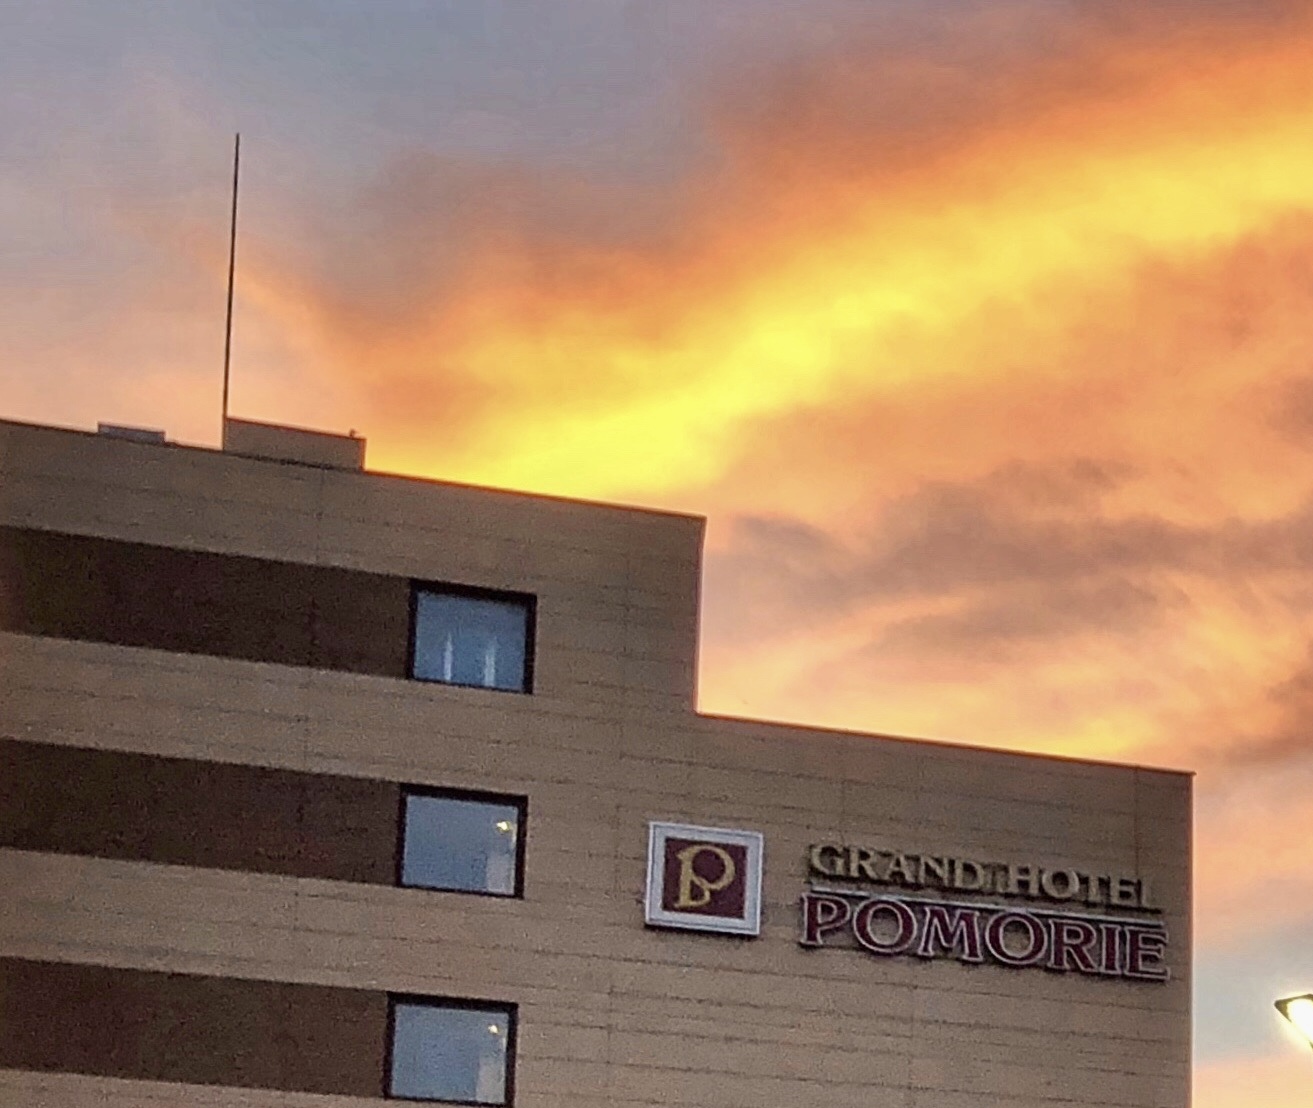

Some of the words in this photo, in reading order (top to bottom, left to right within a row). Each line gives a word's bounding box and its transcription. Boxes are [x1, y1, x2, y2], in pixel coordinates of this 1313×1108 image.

[810, 842, 985, 889] GRAND
[1003, 863, 1158, 908] HOTEL
[799, 892, 1171, 980] POMORIE
